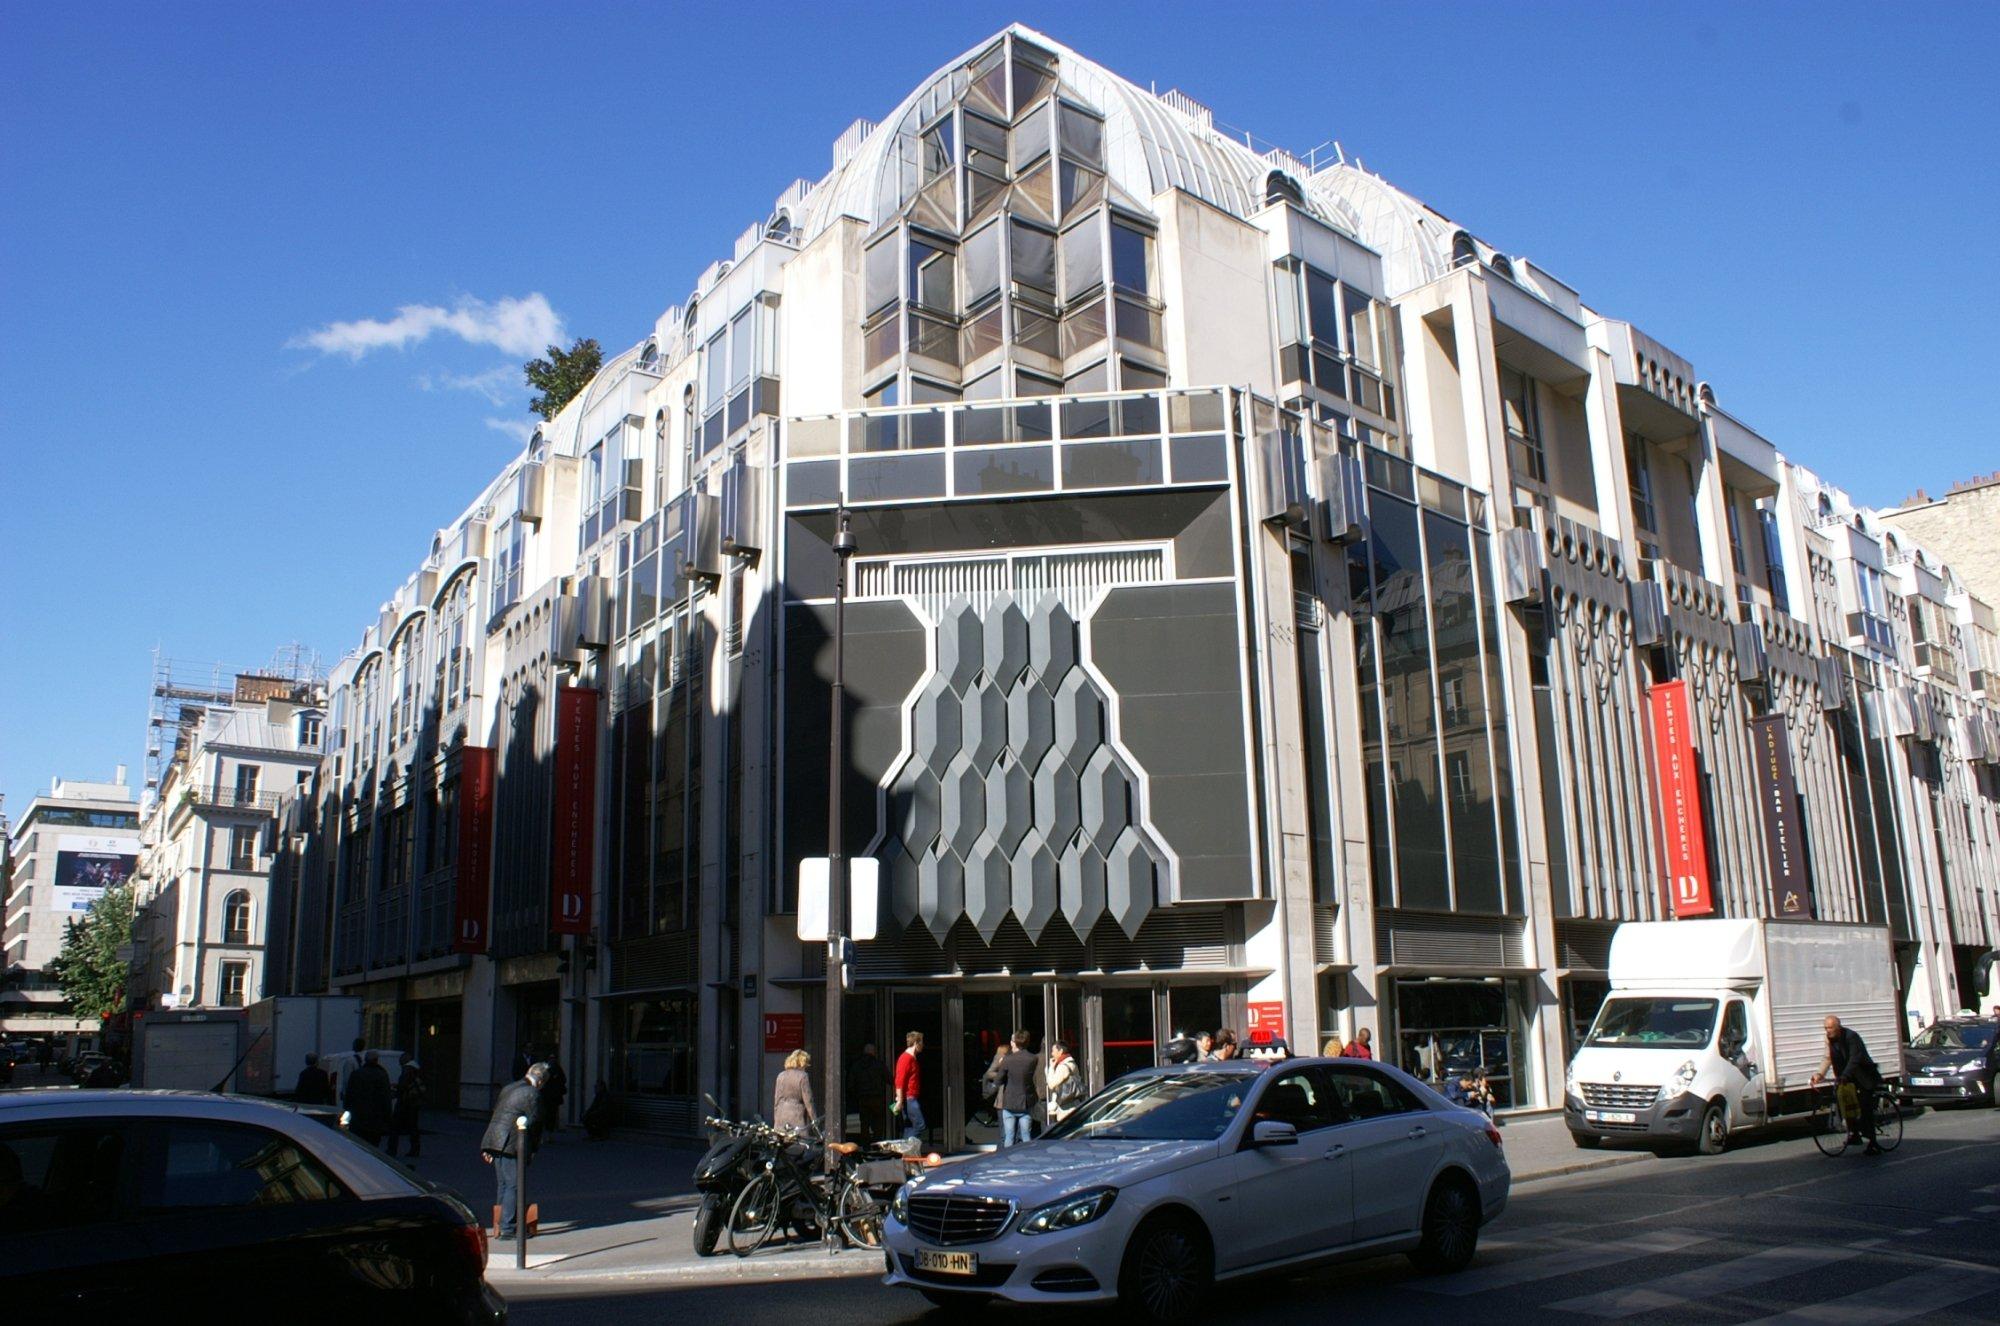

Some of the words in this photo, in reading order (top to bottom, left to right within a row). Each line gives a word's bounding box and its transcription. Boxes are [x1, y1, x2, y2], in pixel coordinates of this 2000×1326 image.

[574, 697, 582, 752] VENTES
[1665, 691, 1676, 744] VENTES
[1672, 754, 1681, 779] AUX
[473, 778, 481, 832] AUCTION
[1675, 789, 1689, 860] ENCHERES
[570, 801, 579, 878] ENCHERES
[1774, 790, 1782, 813] BAR
[1778, 820, 1790, 876] ATELIER
[563, 893, 582, 917] D
[1679, 875, 1699, 897] D
